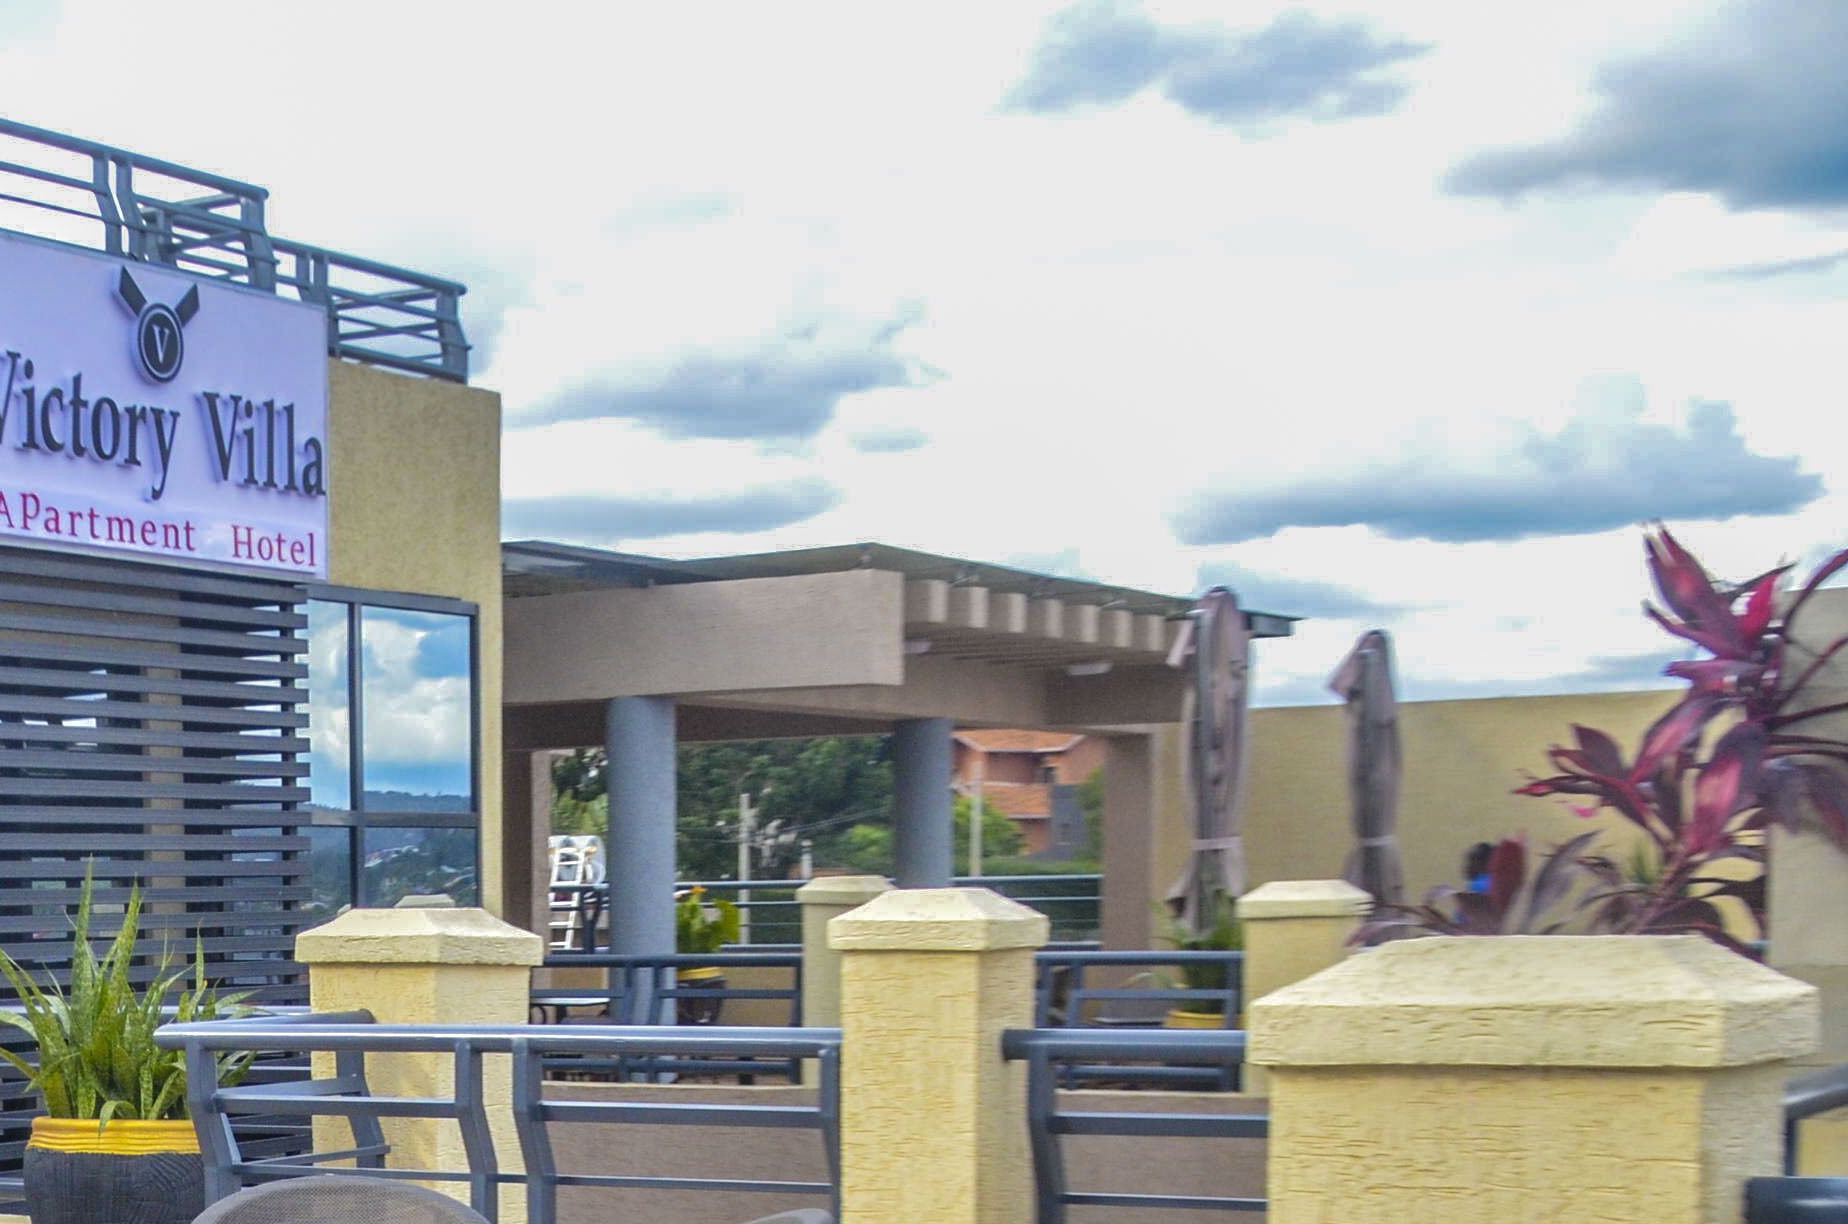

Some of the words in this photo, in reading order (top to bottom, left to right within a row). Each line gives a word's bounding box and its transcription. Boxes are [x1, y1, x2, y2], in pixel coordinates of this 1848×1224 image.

[152, 323, 170, 364] V
[201, 390, 326, 497] Villa
[231, 524, 317, 567] Hotel
